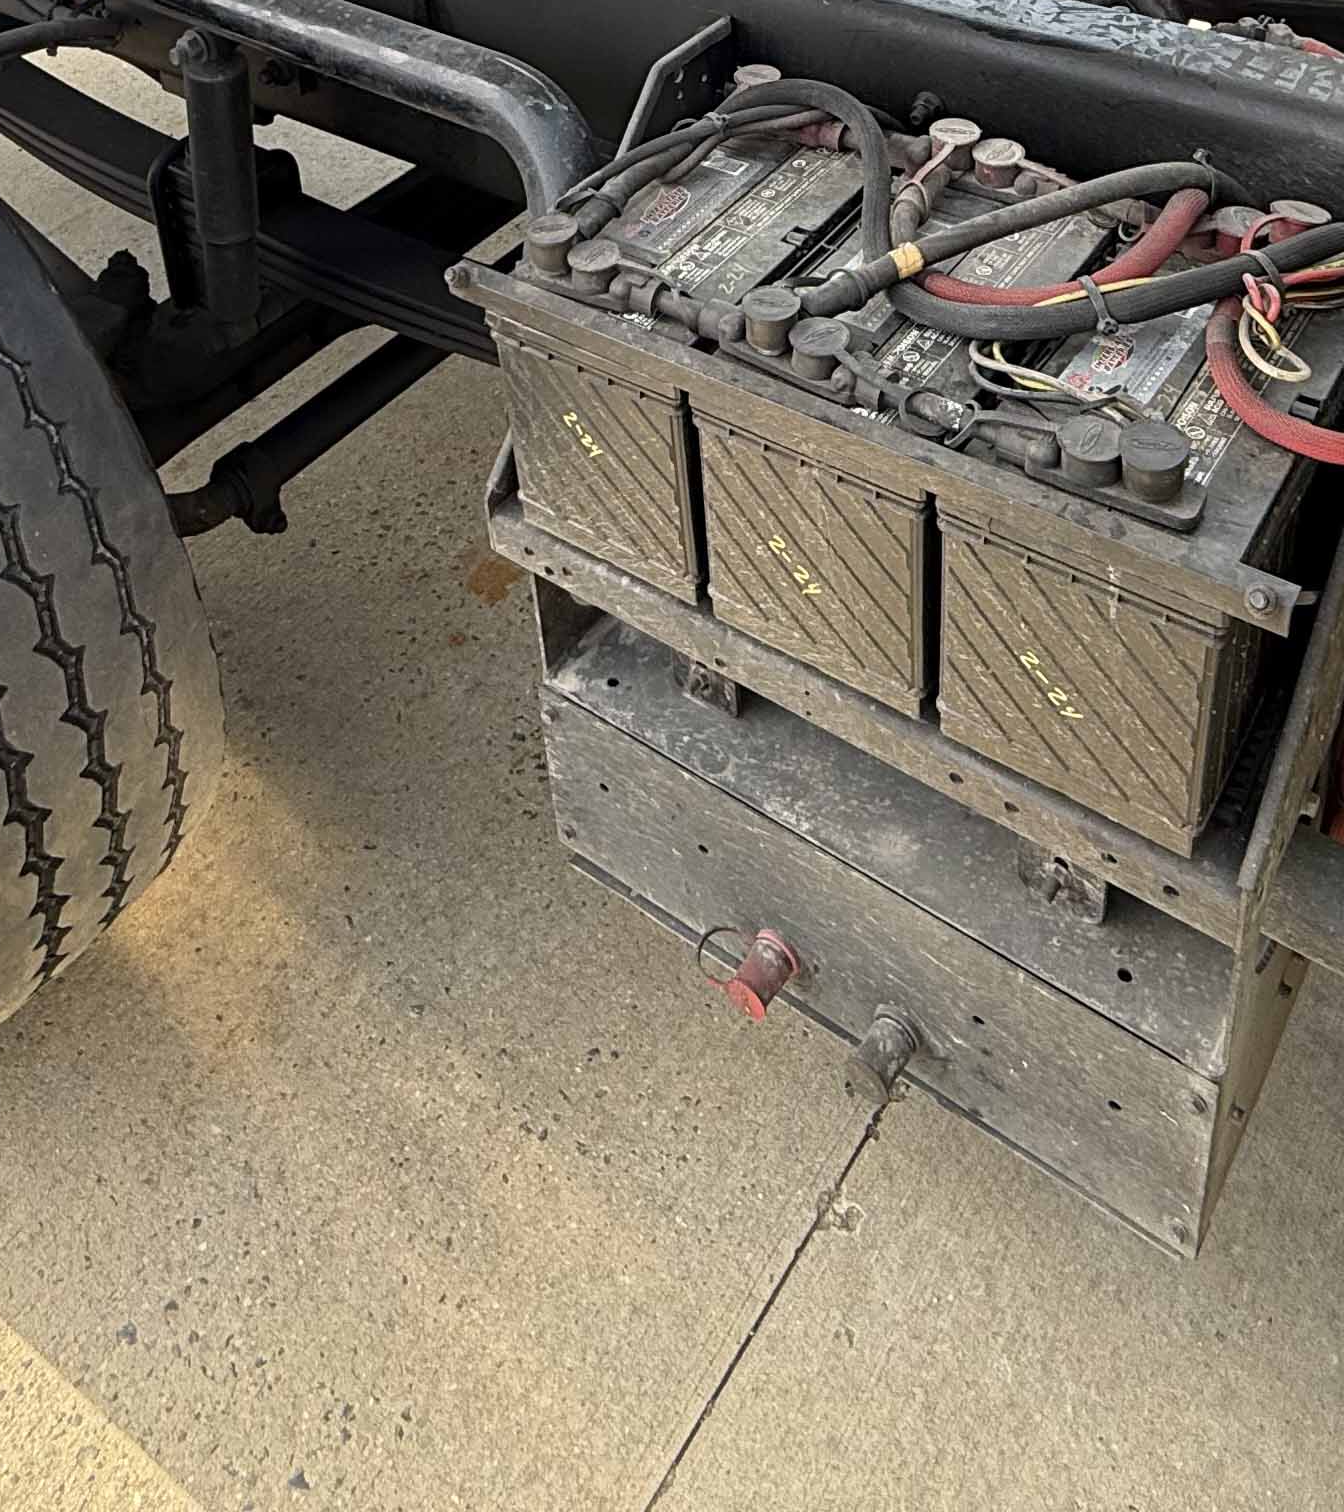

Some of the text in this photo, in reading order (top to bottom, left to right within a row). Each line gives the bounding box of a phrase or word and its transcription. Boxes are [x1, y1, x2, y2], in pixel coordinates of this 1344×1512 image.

[562, 411, 604, 458] 2-24
[768, 534, 822, 594] 2-24
[1019, 650, 1084, 719] 2-24
